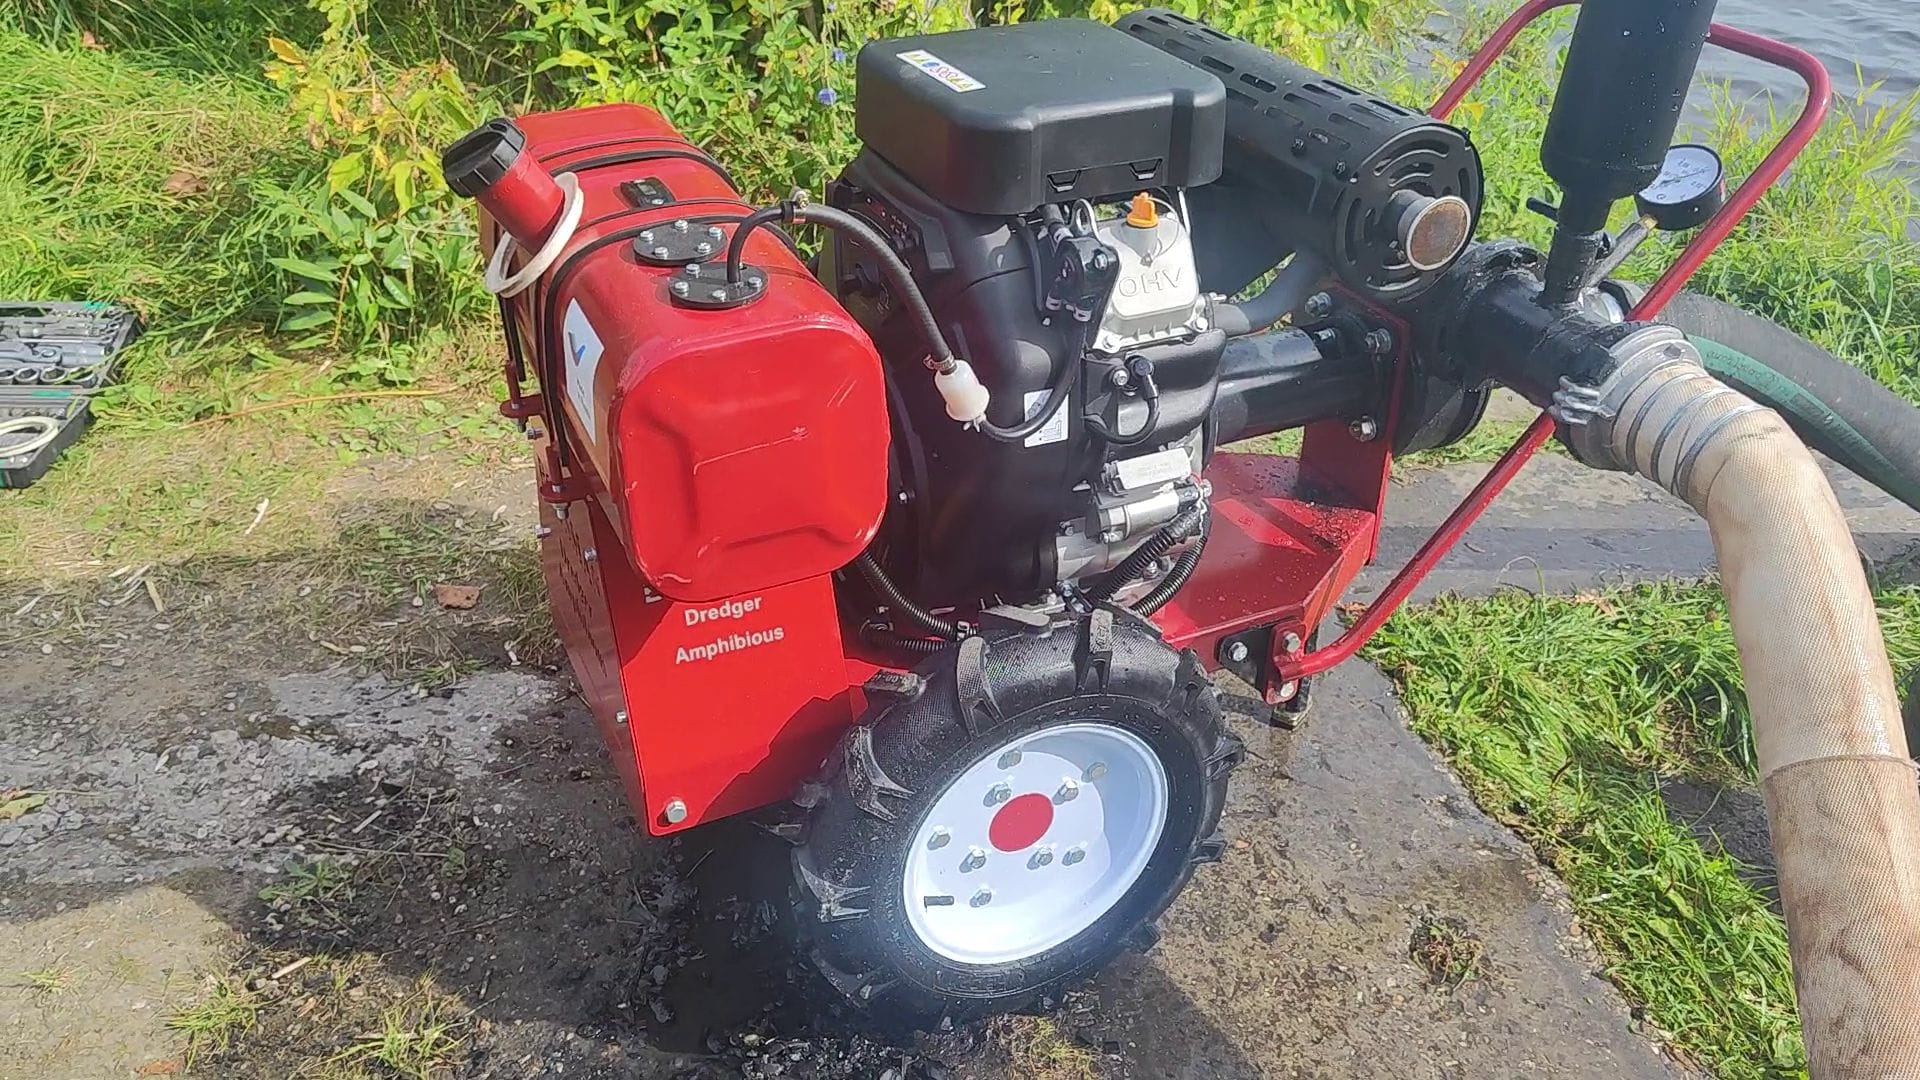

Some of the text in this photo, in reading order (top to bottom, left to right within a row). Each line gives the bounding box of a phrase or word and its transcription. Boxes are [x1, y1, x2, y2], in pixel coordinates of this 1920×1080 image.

[1118, 267, 1181, 297] OHV
[684, 597, 762, 626] Dredger
[675, 627, 785, 665] Amphibious
